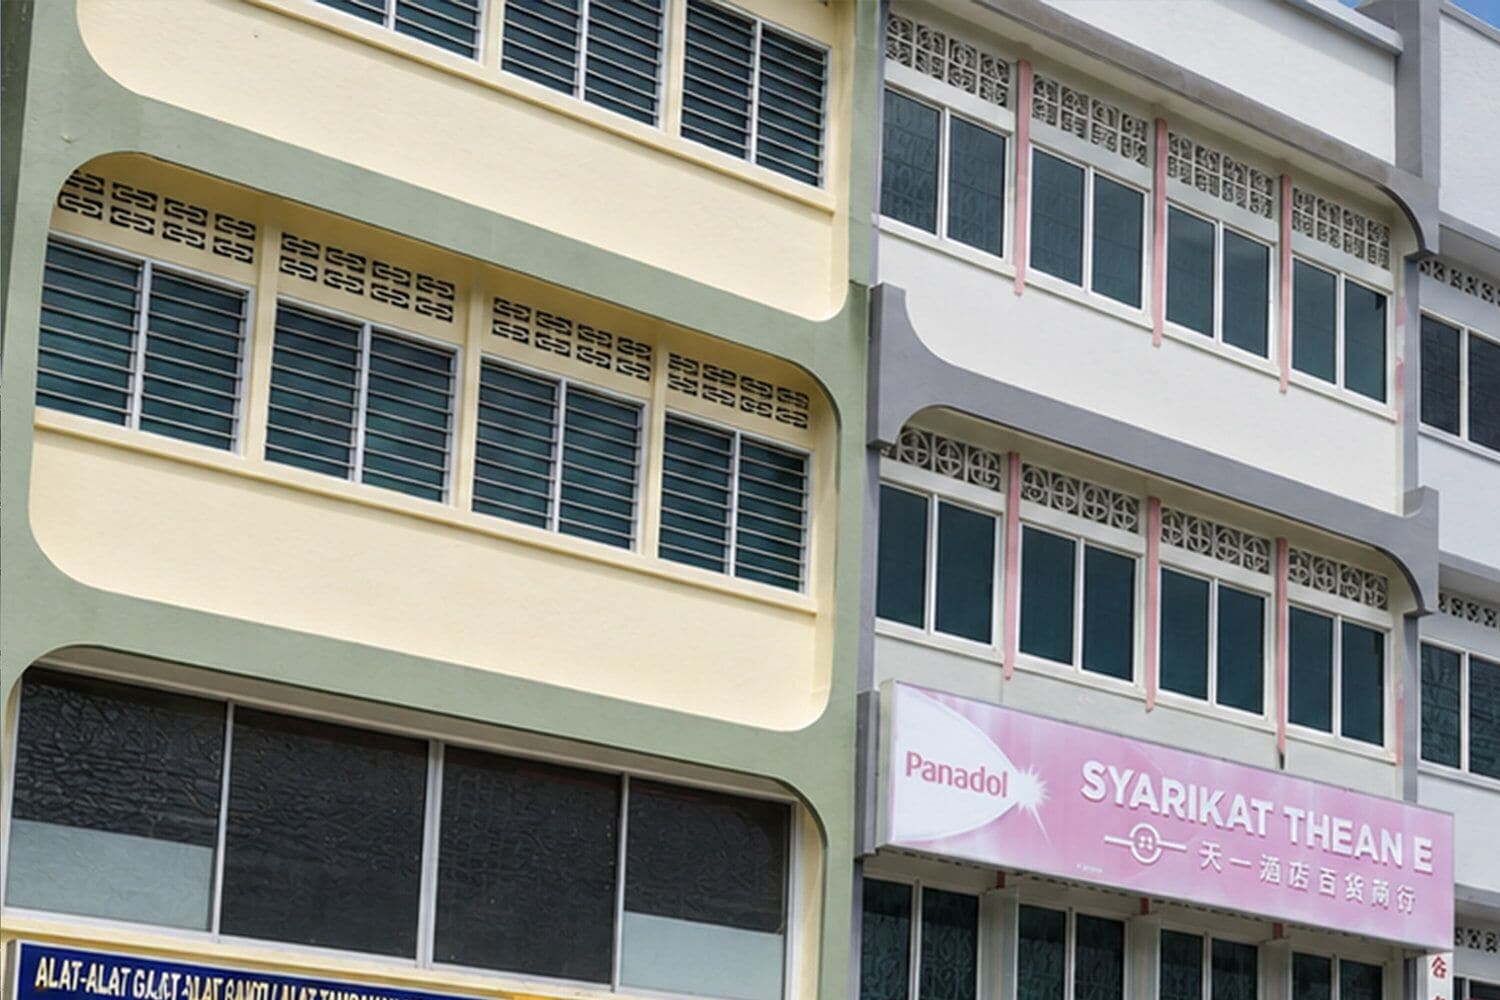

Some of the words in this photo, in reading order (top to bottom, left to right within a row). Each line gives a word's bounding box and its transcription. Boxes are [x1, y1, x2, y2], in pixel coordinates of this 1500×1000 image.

[906, 751, 1008, 798] Panadol
[1081, 760, 1274, 838] SYARIKAT
[1283, 805, 1404, 868] THEAN
[1413, 836, 1434, 874] E
[35, 956, 131, 998] ALAT-ALAT
